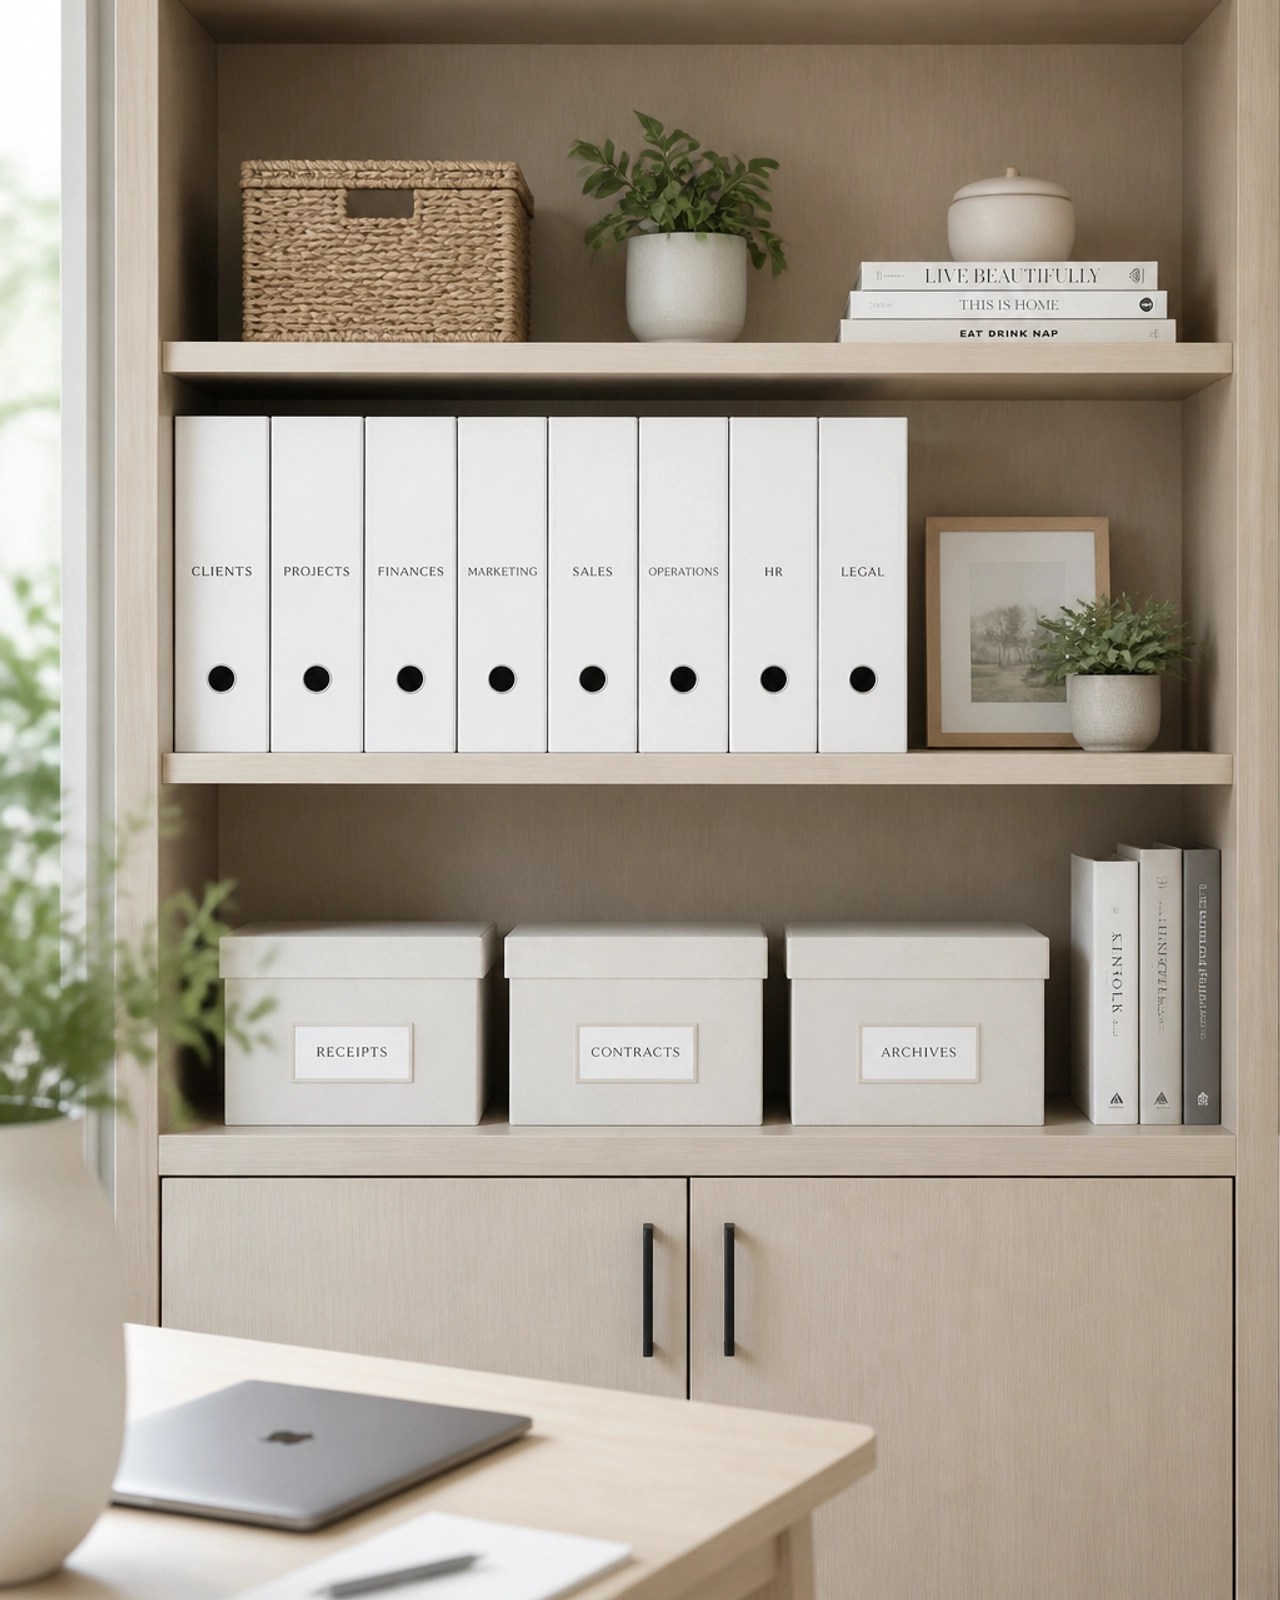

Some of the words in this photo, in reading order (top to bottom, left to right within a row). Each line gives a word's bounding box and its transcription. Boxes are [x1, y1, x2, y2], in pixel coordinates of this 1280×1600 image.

[925, 267, 969, 284] LIVE
[974, 267, 1101, 284] BEAUTIFULLY
[958, 299, 995, 311] THIS
[998, 299, 1011, 311] IS
[1015, 299, 1060, 311] HOME
[959, 329, 984, 338] EAT
[988, 329, 1028, 338] DRINK
[1032, 329, 1059, 338] NAP
[190, 565, 253, 578] CLIENTS
[283, 565, 350, 578] PROJECTS
[377, 566, 444, 577] FINANCES
[467, 566, 538, 577] MARKETING
[572, 566, 613, 577] SALES
[648, 566, 719, 577] OPERATIONS
[764, 566, 784, 577] HR
[841, 566, 885, 578] LEGAL
[316, 1046, 389, 1058] RECEIPTS
[590, 1046, 680, 1058] CONTRACTS
[881, 1046, 957, 1058] ARCHIVES
